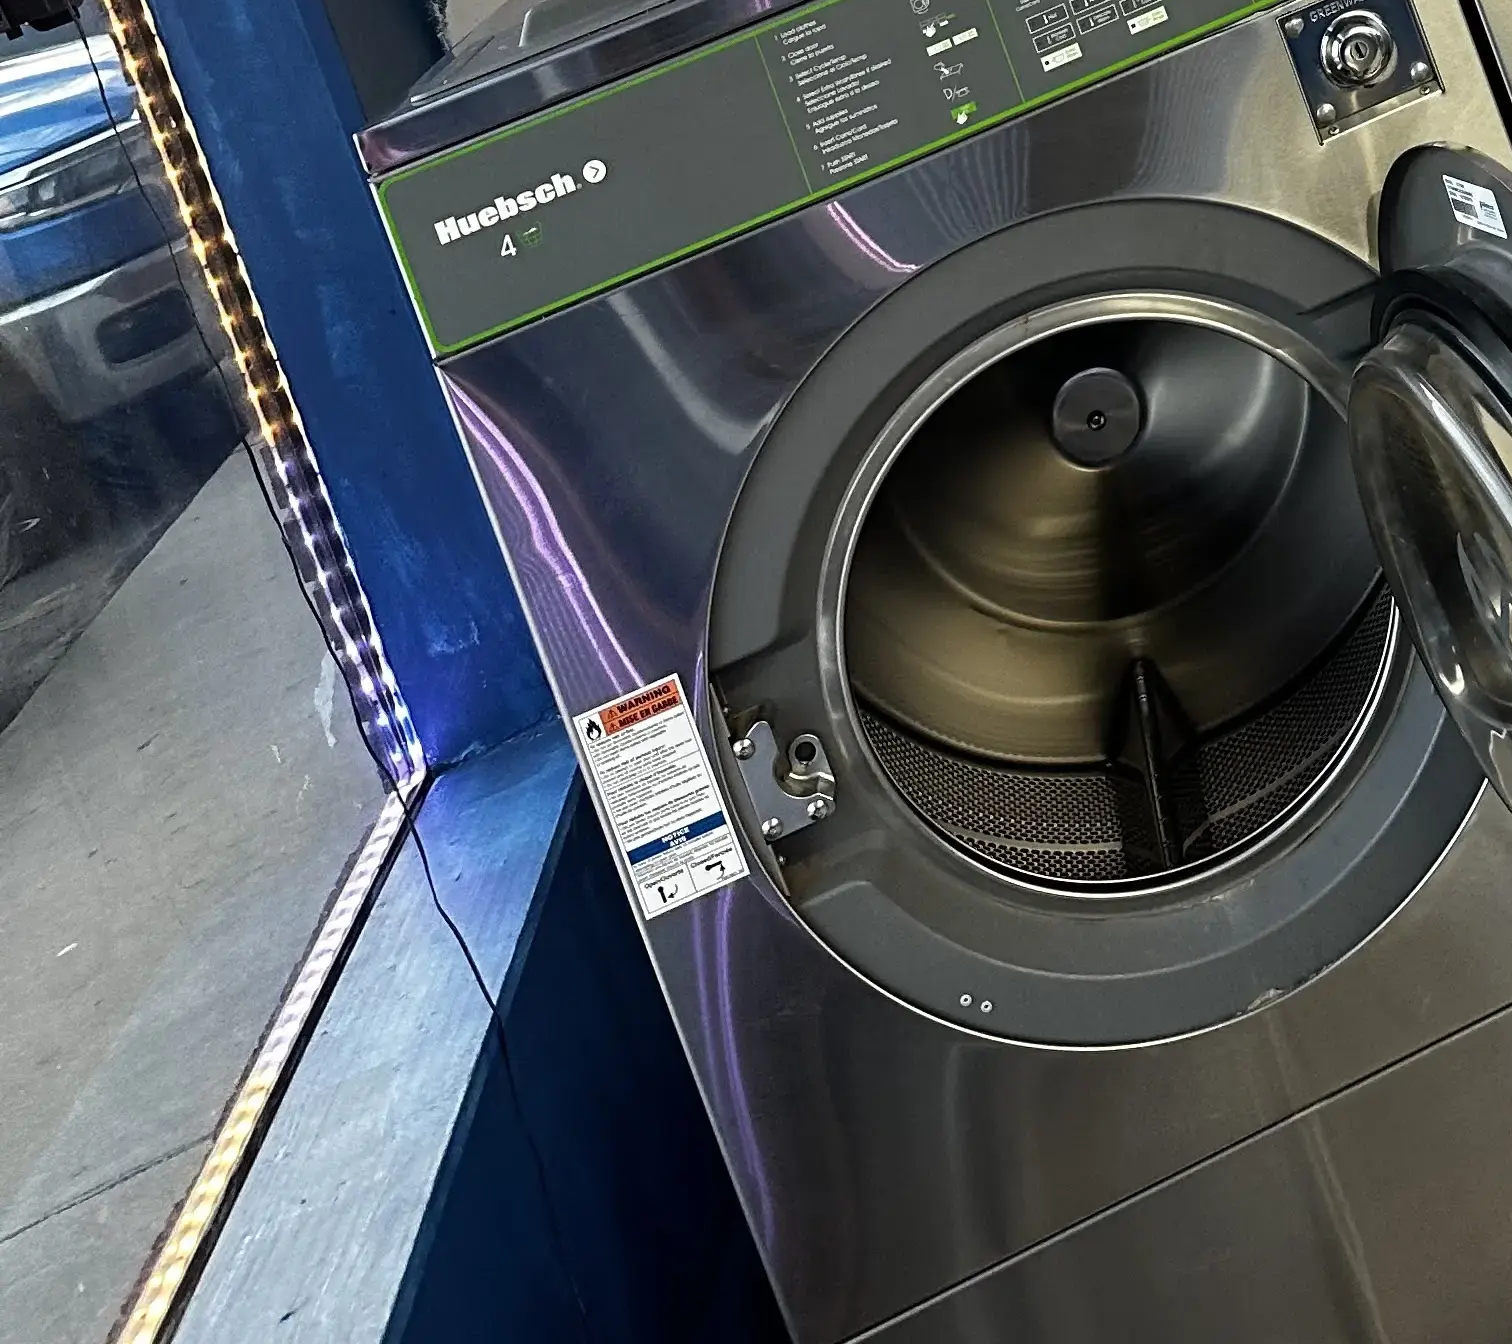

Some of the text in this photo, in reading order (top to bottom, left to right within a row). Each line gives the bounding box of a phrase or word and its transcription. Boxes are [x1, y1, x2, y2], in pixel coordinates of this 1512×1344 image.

[433, 173, 581, 245] Huebsch
[500, 234, 517, 257] 4
[616, 685, 671, 715] WARNING
[618, 712, 639, 727] MISE
[639, 707, 651, 719] EN
